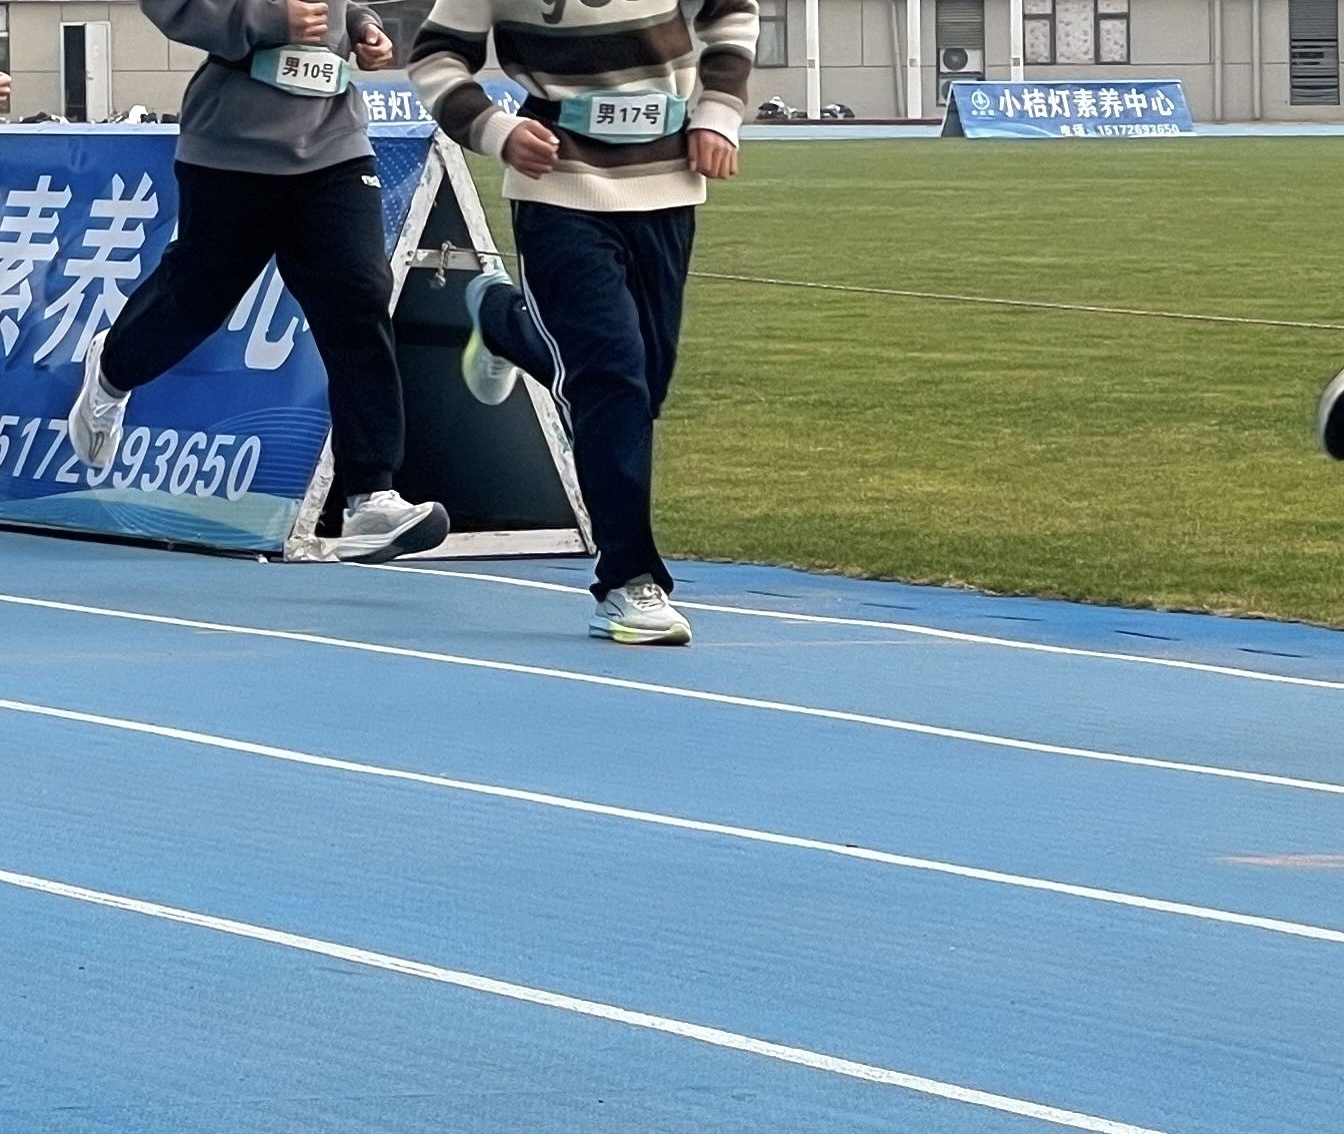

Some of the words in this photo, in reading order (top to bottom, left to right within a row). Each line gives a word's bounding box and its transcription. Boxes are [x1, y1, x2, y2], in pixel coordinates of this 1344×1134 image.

[281, 56, 334, 83] 男10号
[595, 102, 662, 127] 男17号
[999, 88, 1175, 118] 小桔灯素养中心
